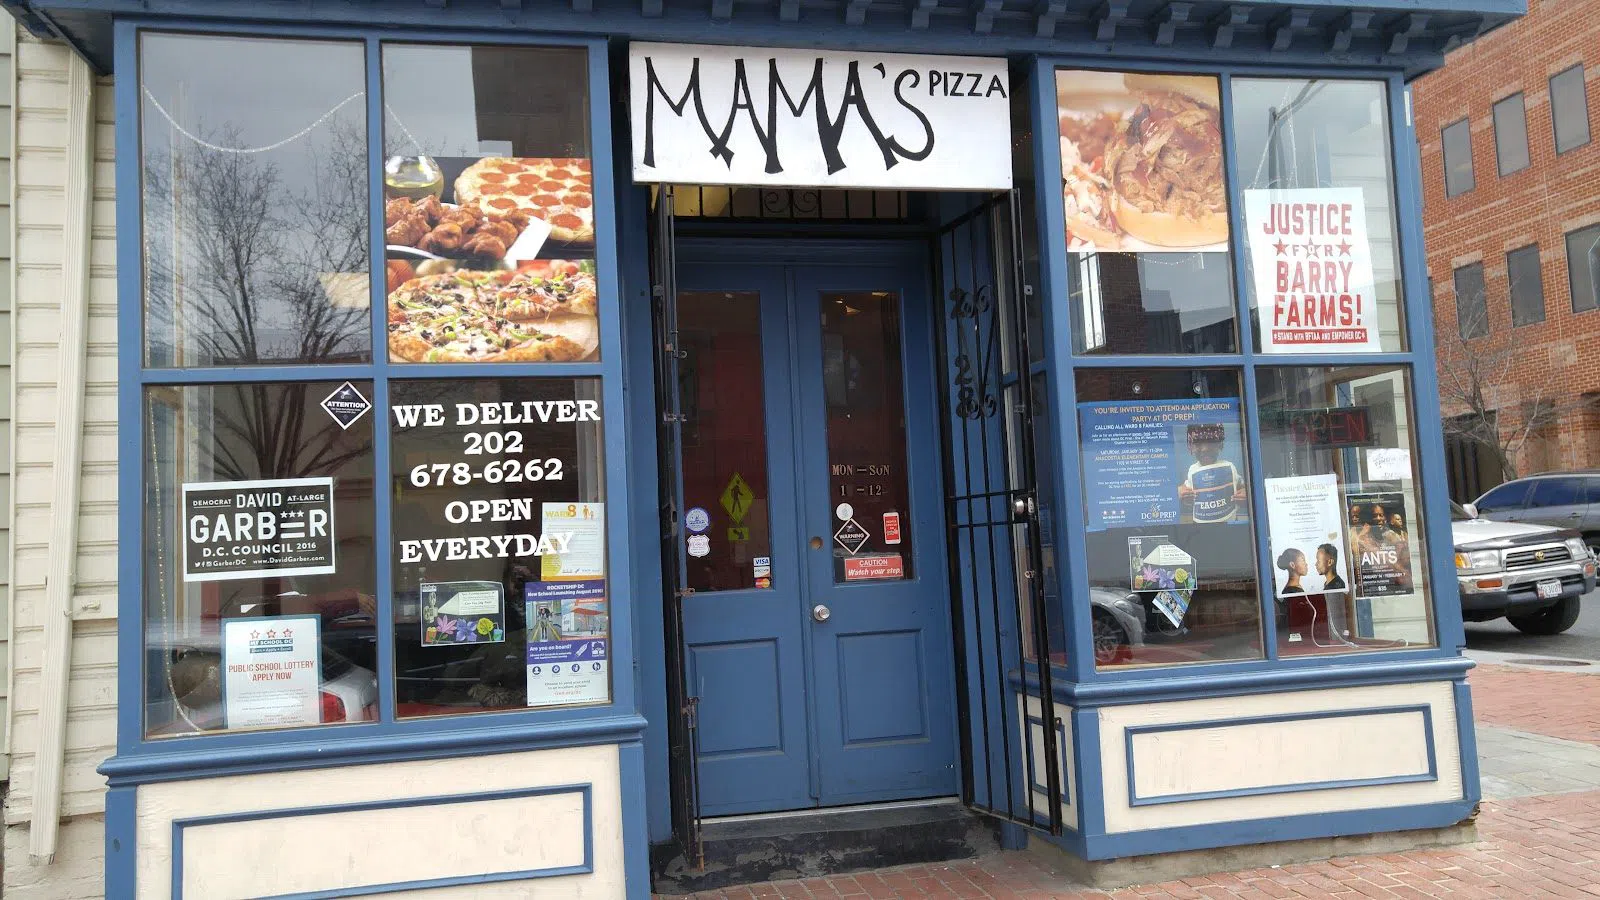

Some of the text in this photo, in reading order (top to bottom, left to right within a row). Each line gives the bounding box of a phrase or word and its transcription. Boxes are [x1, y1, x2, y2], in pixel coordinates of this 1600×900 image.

[642, 56, 1008, 176] MAMA'S PIZZA
[1262, 202, 1353, 236] JUSTICE
[1291, 243, 1335, 257] FOR
[1275, 260, 1354, 294] BARRY
[1273, 294, 1362, 327] FARMS!
[1277, 332, 1293, 341] STAND
[1321, 331, 1331, 341] AND
[1331, 330, 1355, 340] EMPOWER
[326, 400, 366, 409] ATTENTION
[1119, 406, 1146, 414] INVITED
[1155, 404, 1180, 413] ATTEND
[1190, 402, 1231, 412] APPLICATION
[391, 399, 601, 428] WE DELIVER
[1131, 414, 1152, 423] PARTY
[1162, 413, 1173, 421] DC
[1174, 412, 1196, 421] PREP!
[1124, 422, 1139, 430] WARD
[463, 430, 524, 455] 202
[410, 457, 564, 488] 678-6262
[831, 464, 853, 476] MON
[840, 484, 846, 496] 1
[869, 484, 882, 496] 12
[192, 492, 325, 509] DEMOCRAT DAVID AT-LARGE
[1199, 498, 1227, 510] EAGER
[444, 498, 533, 524] OPEN
[567, 504, 577, 518] 8
[1141, 511, 1177, 520] DC PREP
[838, 532, 865, 540] WARNING
[202, 542, 317, 558] D.C. COUNCIL 2016
[399, 531, 574, 564] EVERYDAY
[212, 555, 325, 568] GarberDC www.DavidGarber.com
[859, 558, 888, 567] CAUTION
[1360, 550, 1398, 566] ANTS
[847, 568, 869, 577] Watch
[870, 568, 886, 577] your
[552, 589, 576, 597] Launching
[575, 588, 592, 596] August
[228, 660, 315, 673] PUBLIC SCHOOL LOTTERY
[252, 671, 292, 682] APPLY NOW
